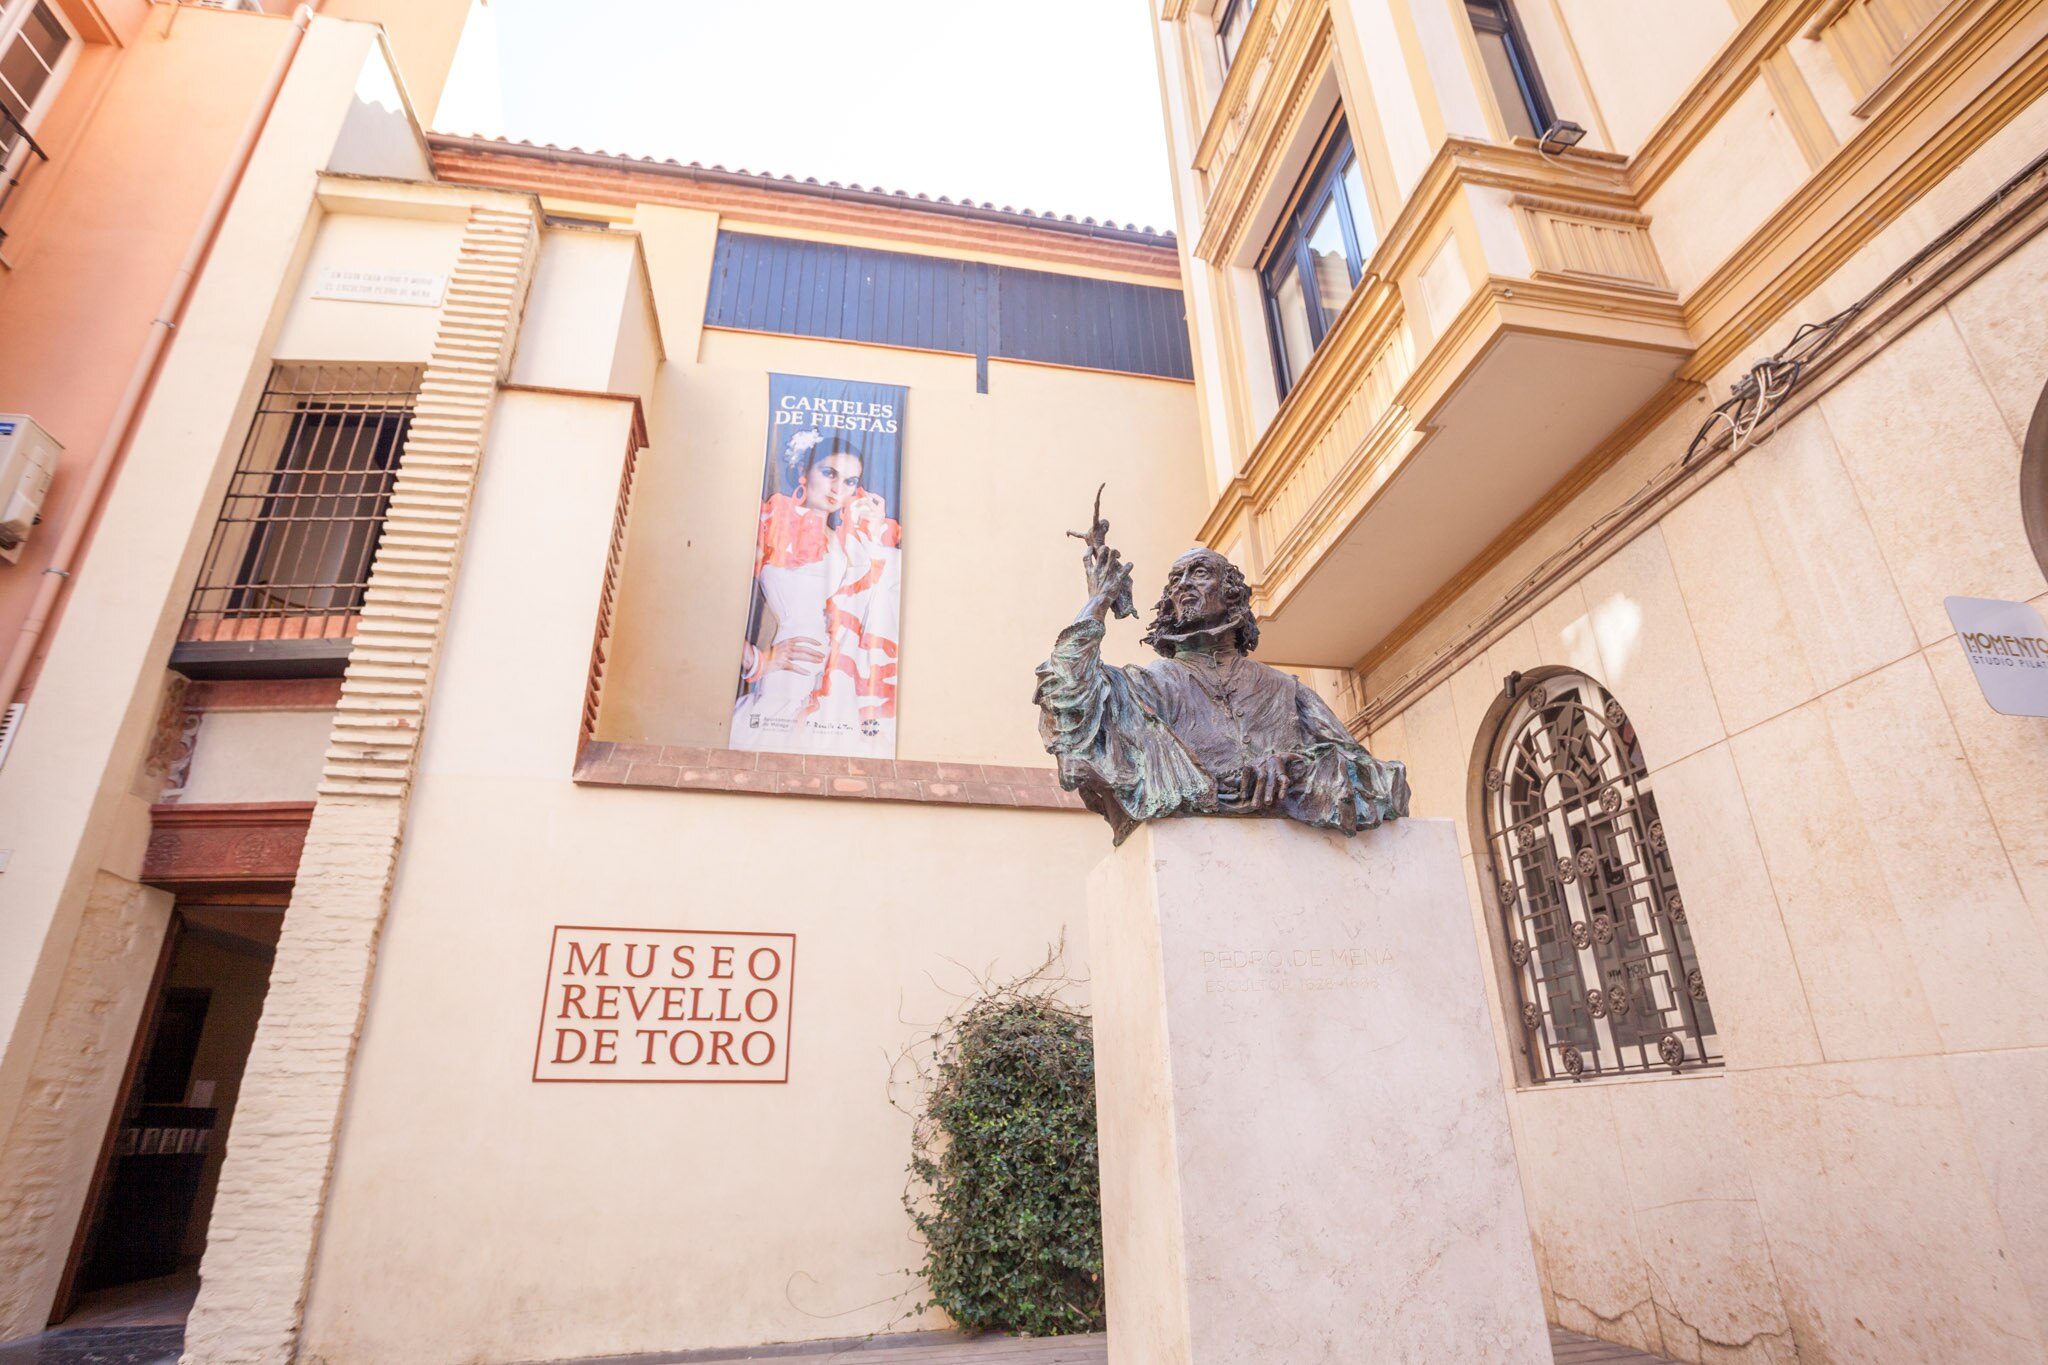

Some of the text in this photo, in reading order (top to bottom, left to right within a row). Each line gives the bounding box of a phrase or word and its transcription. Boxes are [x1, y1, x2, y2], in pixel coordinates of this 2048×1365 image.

[780, 395, 893, 418] CARTELES
[774, 410, 898, 434] DE FIESTAS
[1961, 631, 2048, 659] MOMENTO
[1972, 655, 2015, 667] STUDIO
[562, 941, 781, 982] MUSEO
[1202, 948, 1393, 968] PEDRO DE MENA
[556, 983, 779, 1023] REVELLO
[550, 1028, 776, 1067] DE TORO
